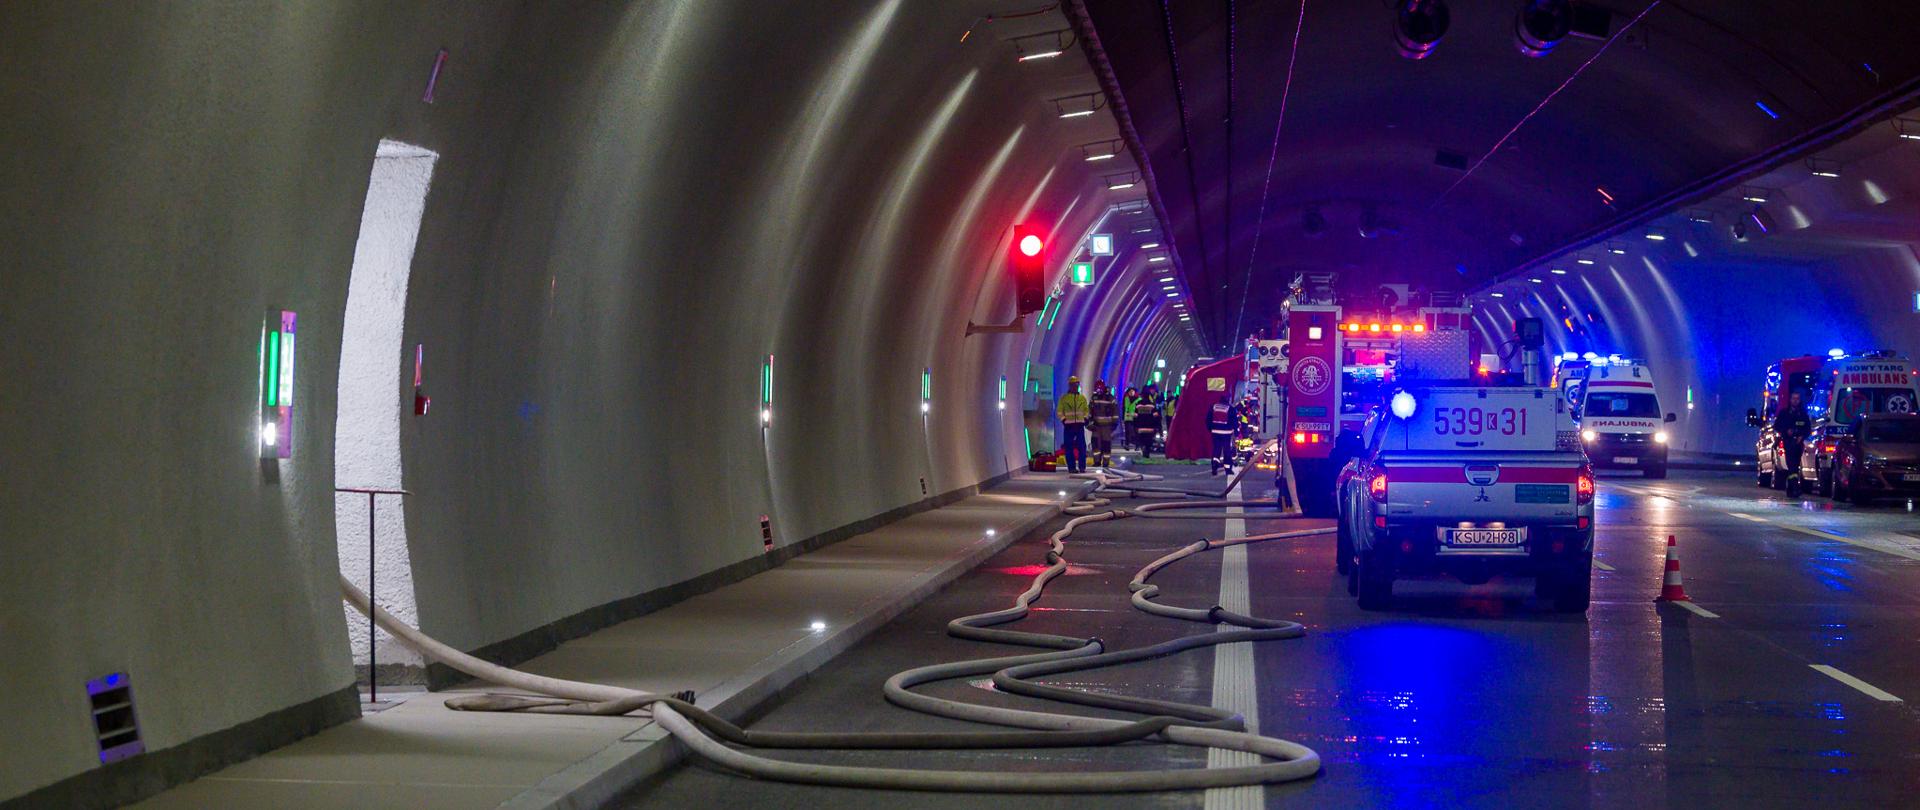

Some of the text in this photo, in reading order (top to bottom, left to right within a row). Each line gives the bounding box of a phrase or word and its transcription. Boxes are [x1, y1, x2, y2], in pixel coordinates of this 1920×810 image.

[1842, 373, 1908, 385] AMBULANS
[1455, 532, 1515, 544] KSU 2H98
